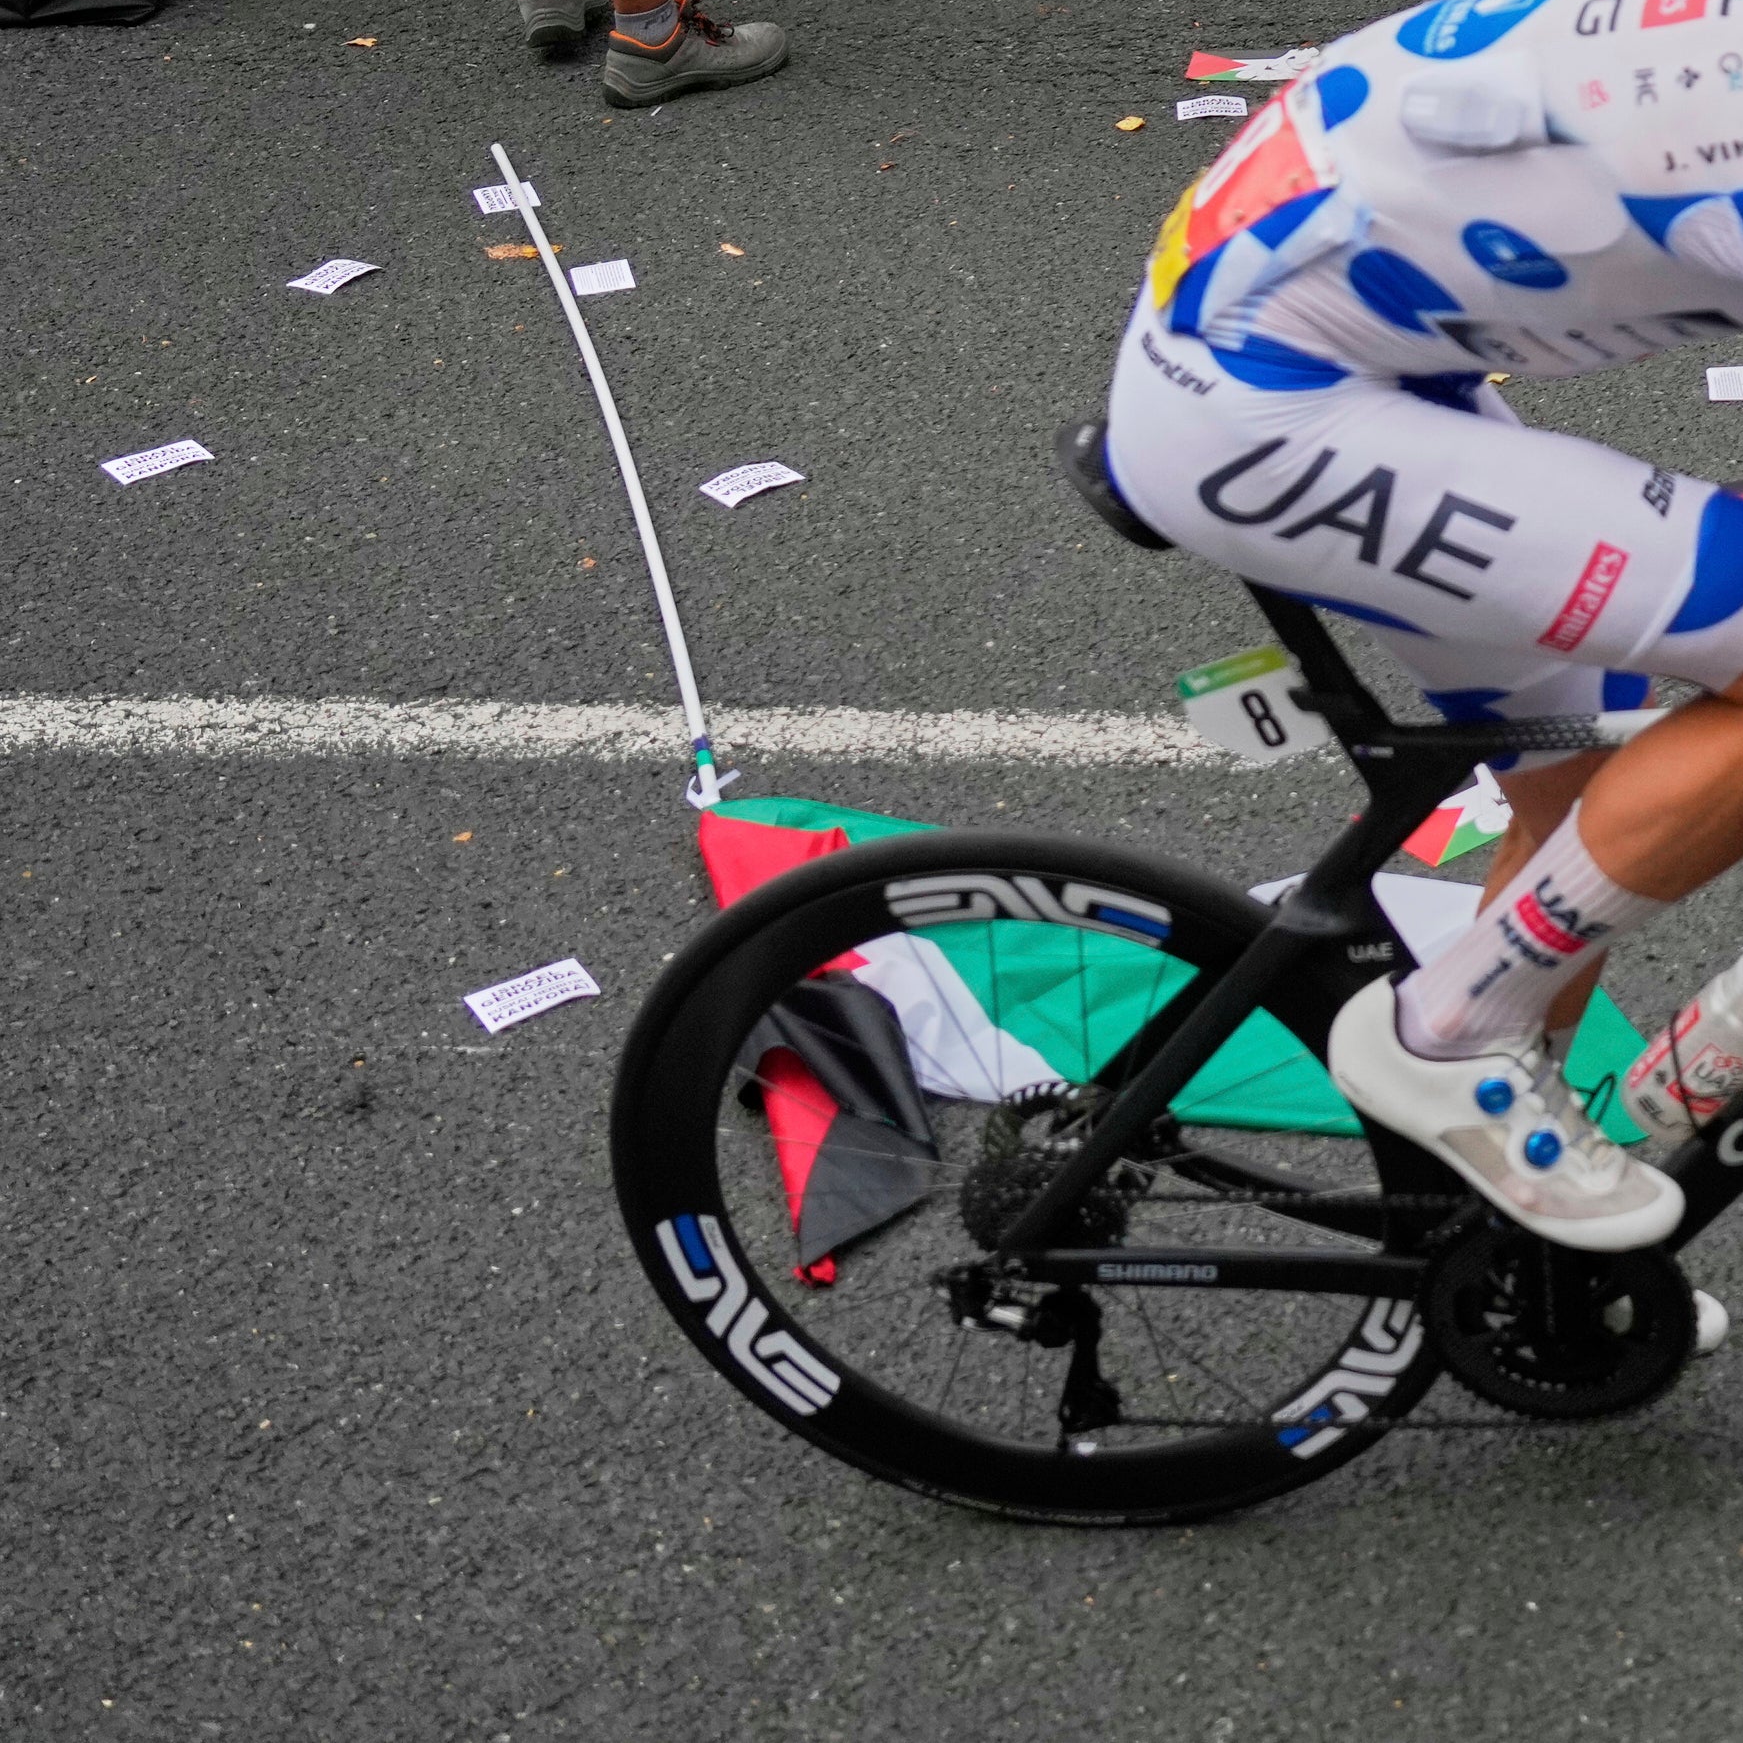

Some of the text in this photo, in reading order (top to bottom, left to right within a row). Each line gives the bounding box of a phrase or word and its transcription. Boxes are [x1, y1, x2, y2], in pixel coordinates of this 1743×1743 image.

[1199, 438, 1516, 602] UAE
[1240, 688, 1288, 748] 8
[1347, 940, 1395, 963] UAE
[481, 970, 579, 1008] GENOZIDA
[492, 970, 556, 997] ISRAEL
[492, 982, 591, 1023] KANPORA!
[1097, 1262, 1219, 1283] SHIMANO
